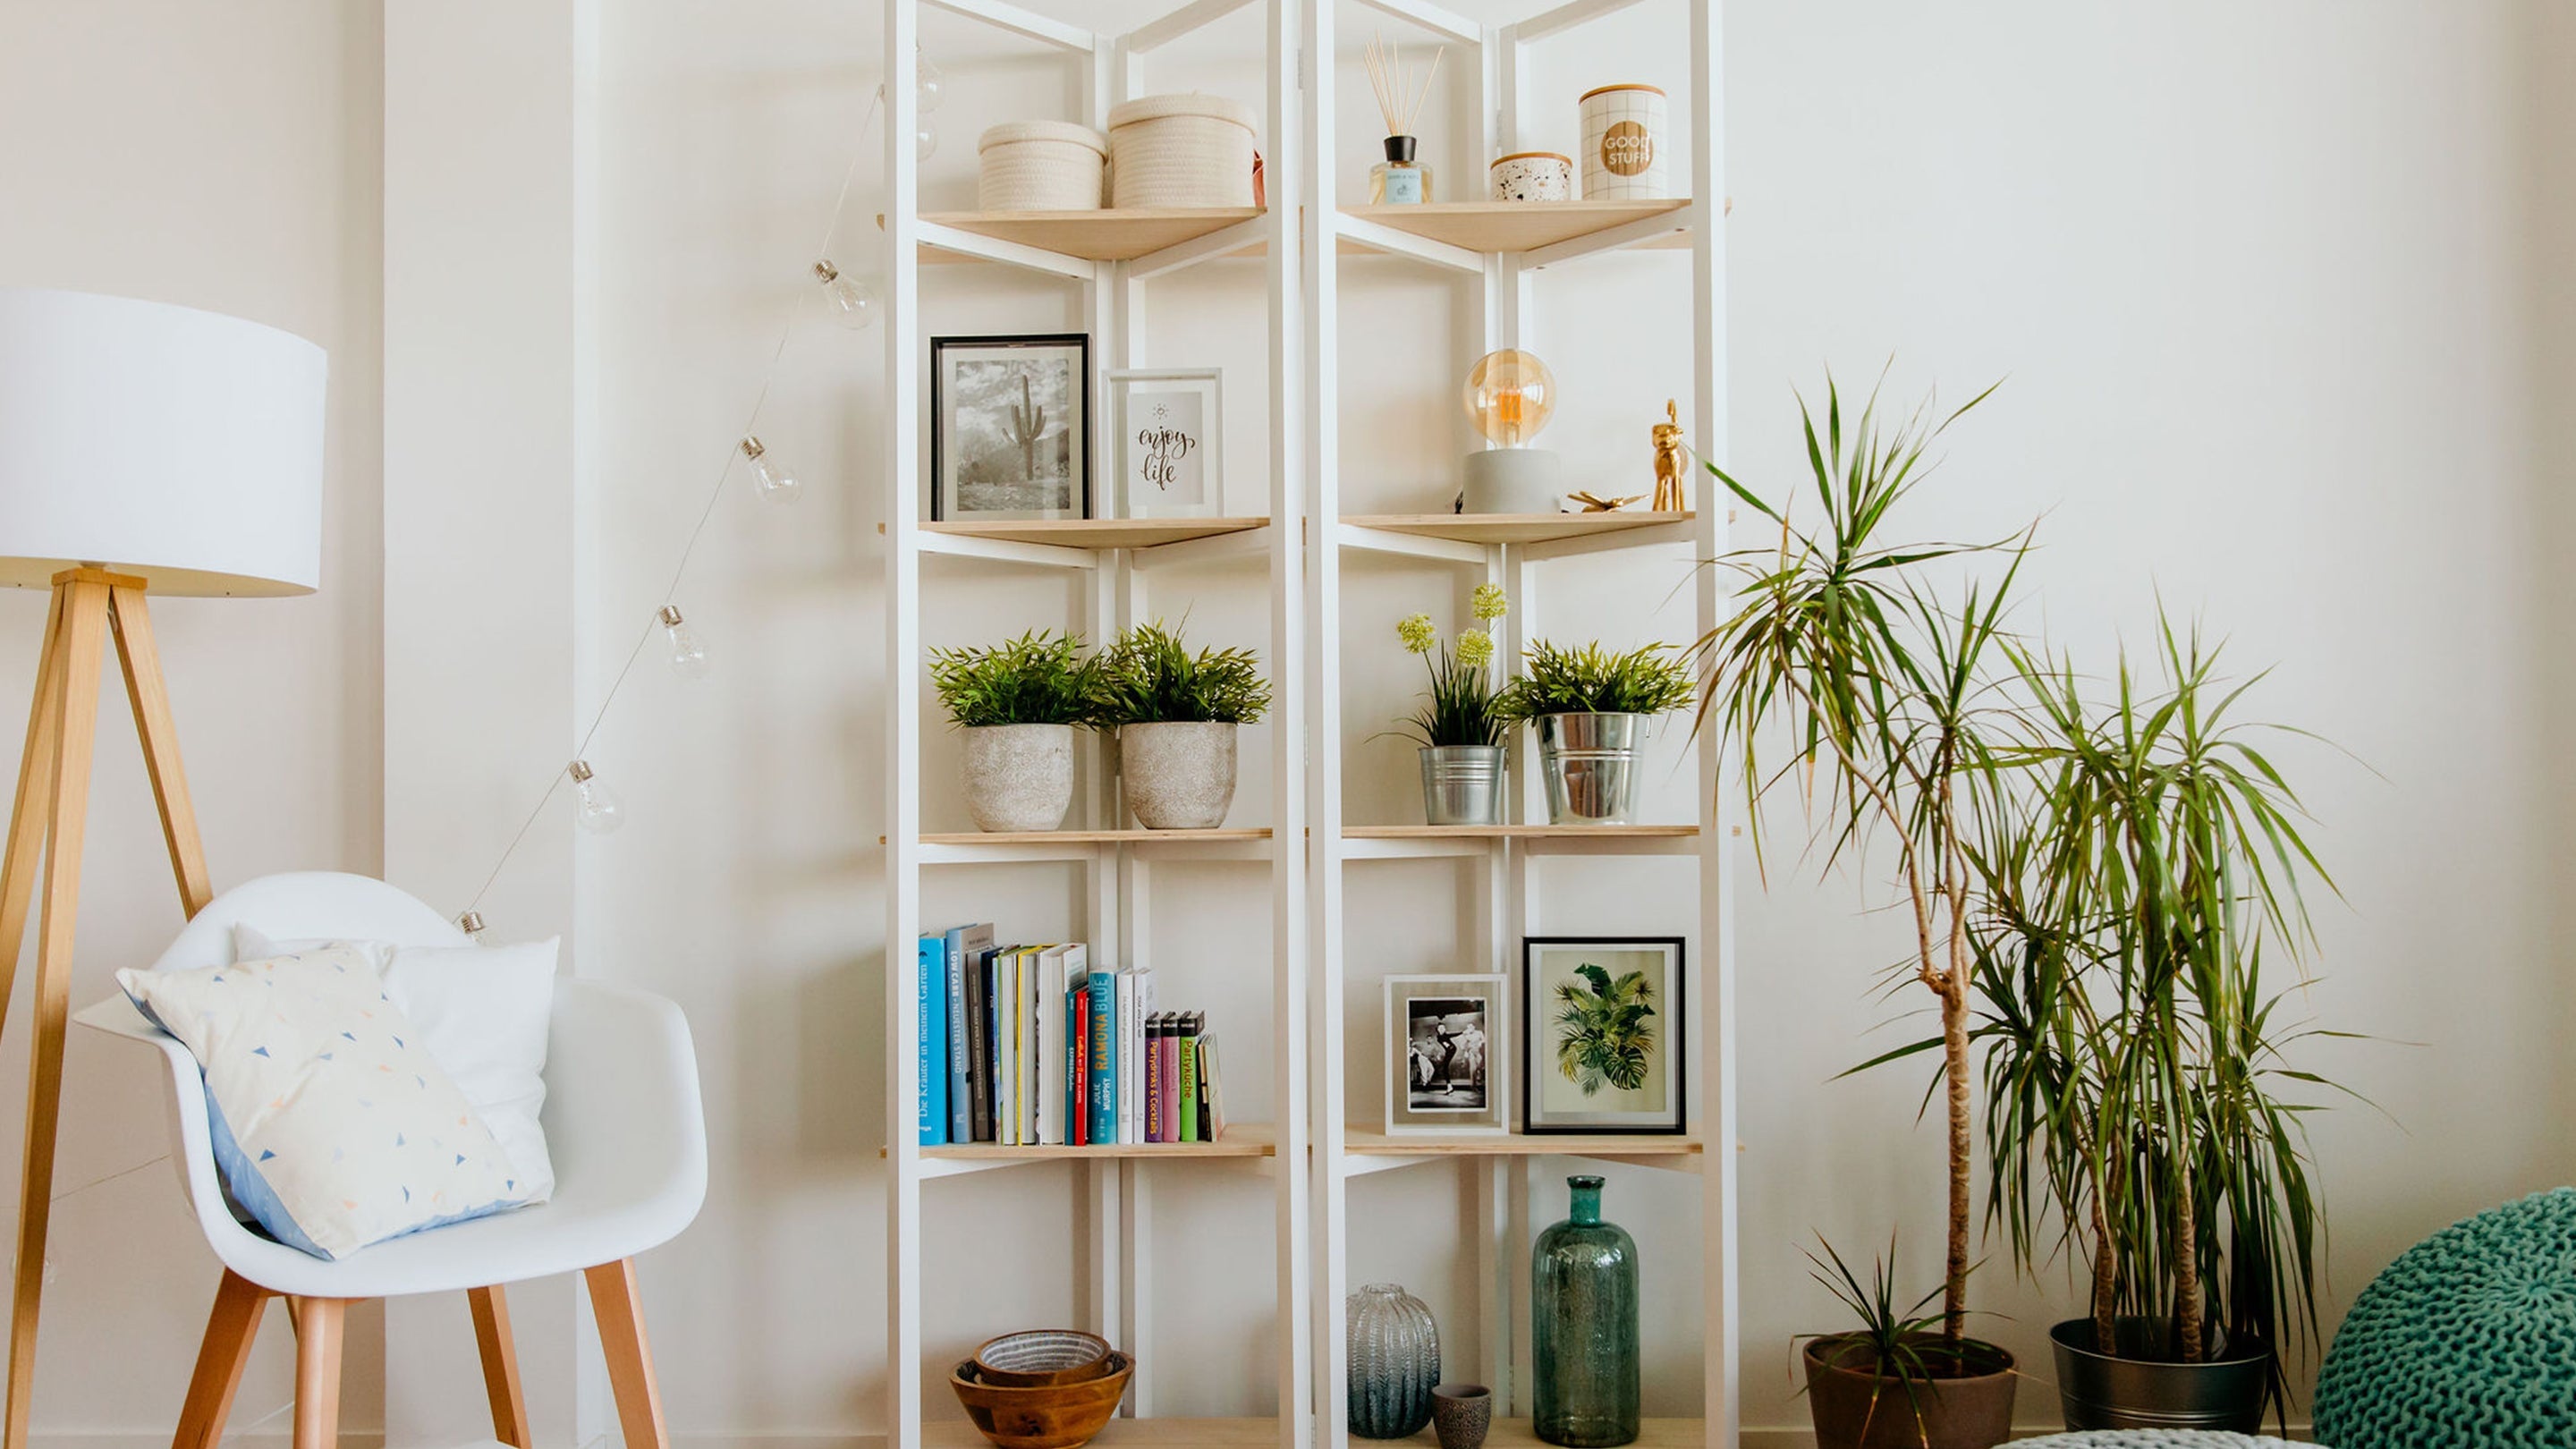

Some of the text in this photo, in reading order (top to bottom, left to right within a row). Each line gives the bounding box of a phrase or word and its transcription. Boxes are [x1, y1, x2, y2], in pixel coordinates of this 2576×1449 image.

[1605, 136, 1648, 150] GOOD
[1609, 152, 1648, 165] STUFF
[1139, 426, 1196, 460] enjoy
[1140, 453, 1176, 491] life
[918, 964, 928, 1000] Garten
[1094, 979, 1109, 1071] RAMONA BLUE
[953, 1046, 962, 1073] STAND
[1149, 1041, 1158, 1088] Partydrinks
[1182, 1040, 1194, 1098] Partyküche
[1103, 1078, 1111, 1111] MURPHY
[1149, 1097, 1159, 1134] Cocktails
